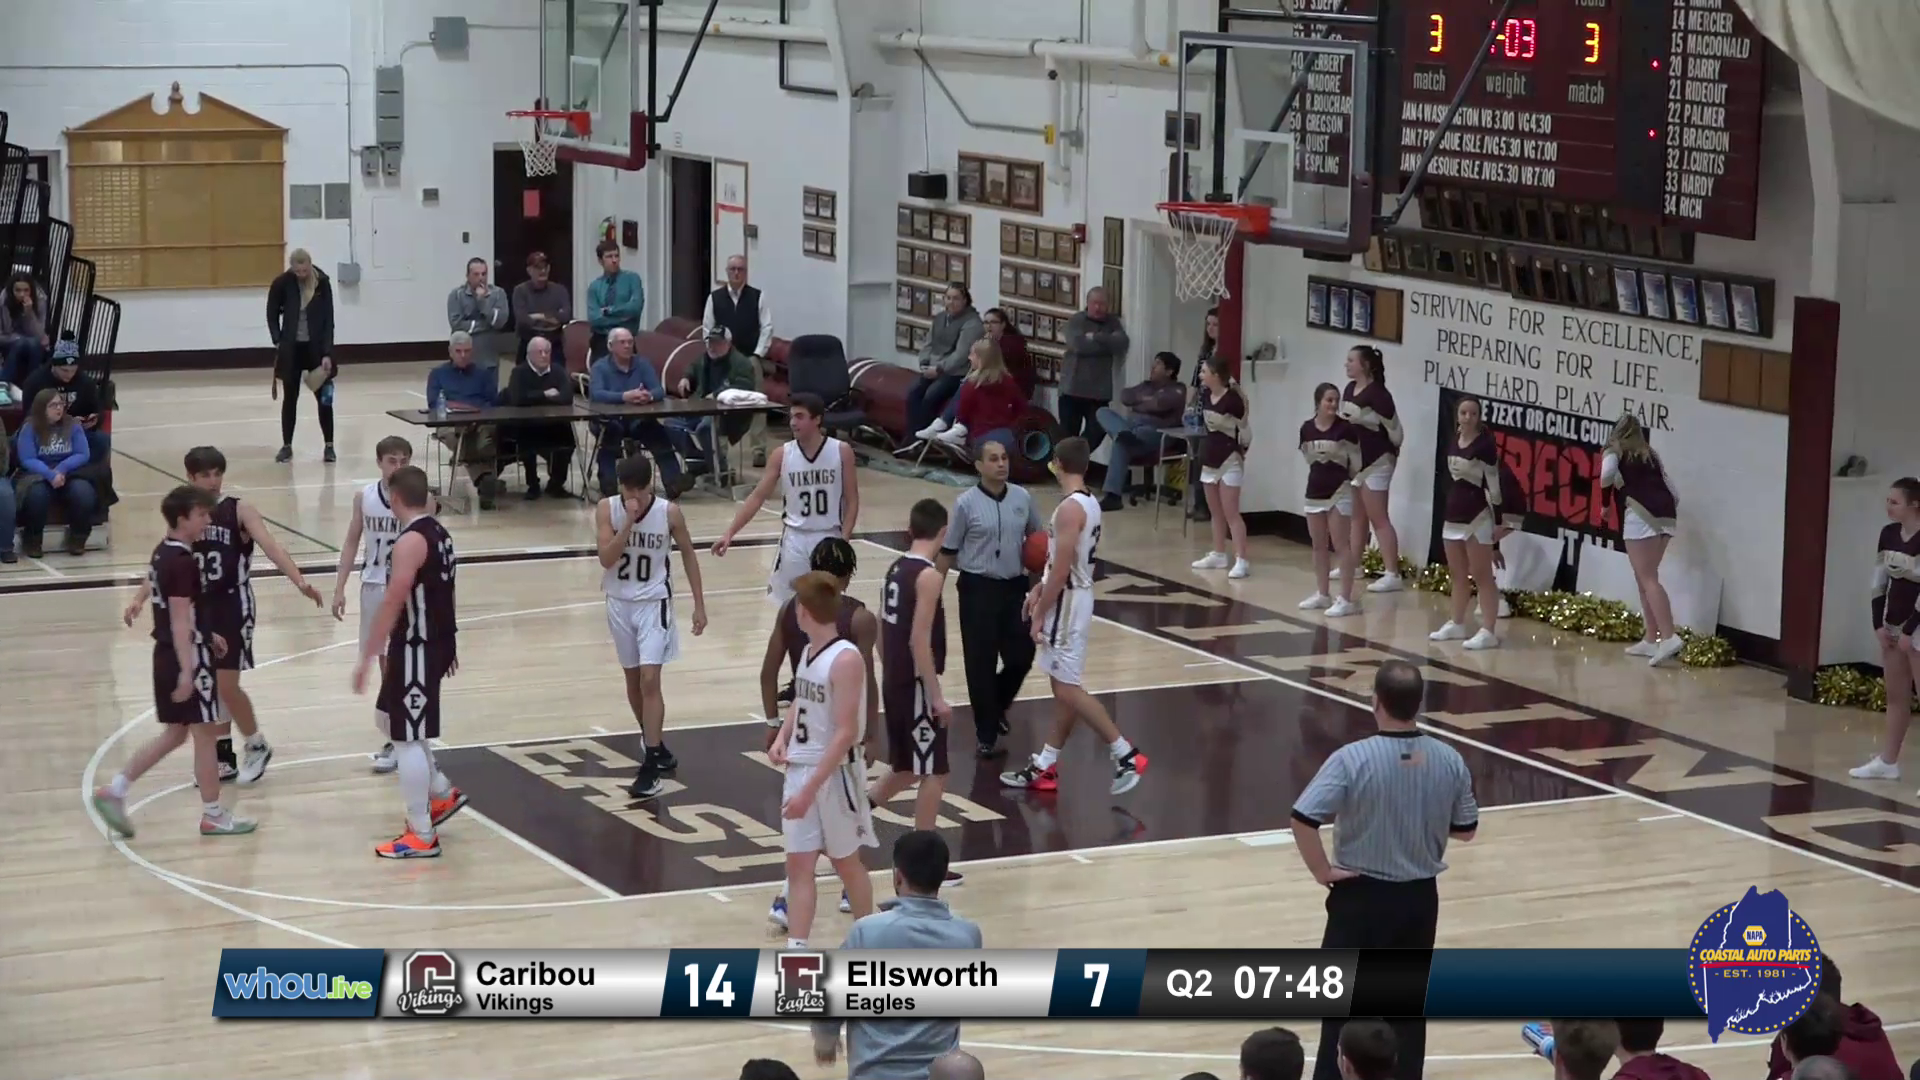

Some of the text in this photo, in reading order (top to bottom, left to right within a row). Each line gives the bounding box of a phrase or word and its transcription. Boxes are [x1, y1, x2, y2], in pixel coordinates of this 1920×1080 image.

[1429, 14, 1443, 53] 3
[1672, 9, 1733, 34] 14 MERCIER
[1585, 22, 1599, 63] 3
[1671, 32, 1750, 59] 15 MACDONALD
[1311, 54, 1345, 73] ERBERT
[1669, 56, 1721, 80] 20 BARRY
[1413, 69, 1446, 92] match
[1486, 72, 1526, 98] weight
[1568, 80, 1605, 105] match
[1669, 79, 1728, 105] 21 RIDEOUT
[1305, 113, 1343, 133] GREGSON
[1402, 101, 1416, 121] JAN
[1417, 103, 1423, 122] 4
[1424, 103, 1479, 127] WASGTON
[1667, 101, 1725, 128] 22 PALMER
[1401, 126, 1416, 147] JAN
[1417, 128, 1423, 147] 7
[1423, 129, 1461, 151] PRQUE
[1462, 133, 1481, 153] ISLE
[1667, 125, 1730, 152] 23 BRAGDON
[1400, 152, 1416, 172] JAN
[1427, 156, 1460, 176] RESQUE
[1461, 158, 1480, 179] ISLE
[1666, 148, 1725, 175] 32 J.CURTIS
[1665, 171, 1715, 197] 33 HARDY
[1664, 193, 1703, 219] 34 RICH
[1410, 291, 1700, 365] STRIVING FOR EXCELLENCE,
[1437, 328, 1663, 394] PREPARING FOR LIFE.
[1424, 360, 1675, 432] PLAY HARD. PLAY FAIR.
[1491, 401, 1524, 429] TEXT
[1525, 407, 1545, 433] OR
[1545, 411, 1579, 440] CALL
[788, 468, 836, 488] VIKINGS
[799, 489, 828, 517] 30
[364, 514, 402, 533] VIKIN
[617, 552, 652, 583] 20
[796, 707, 809, 744] 5
[919, 726, 930, 743] E
